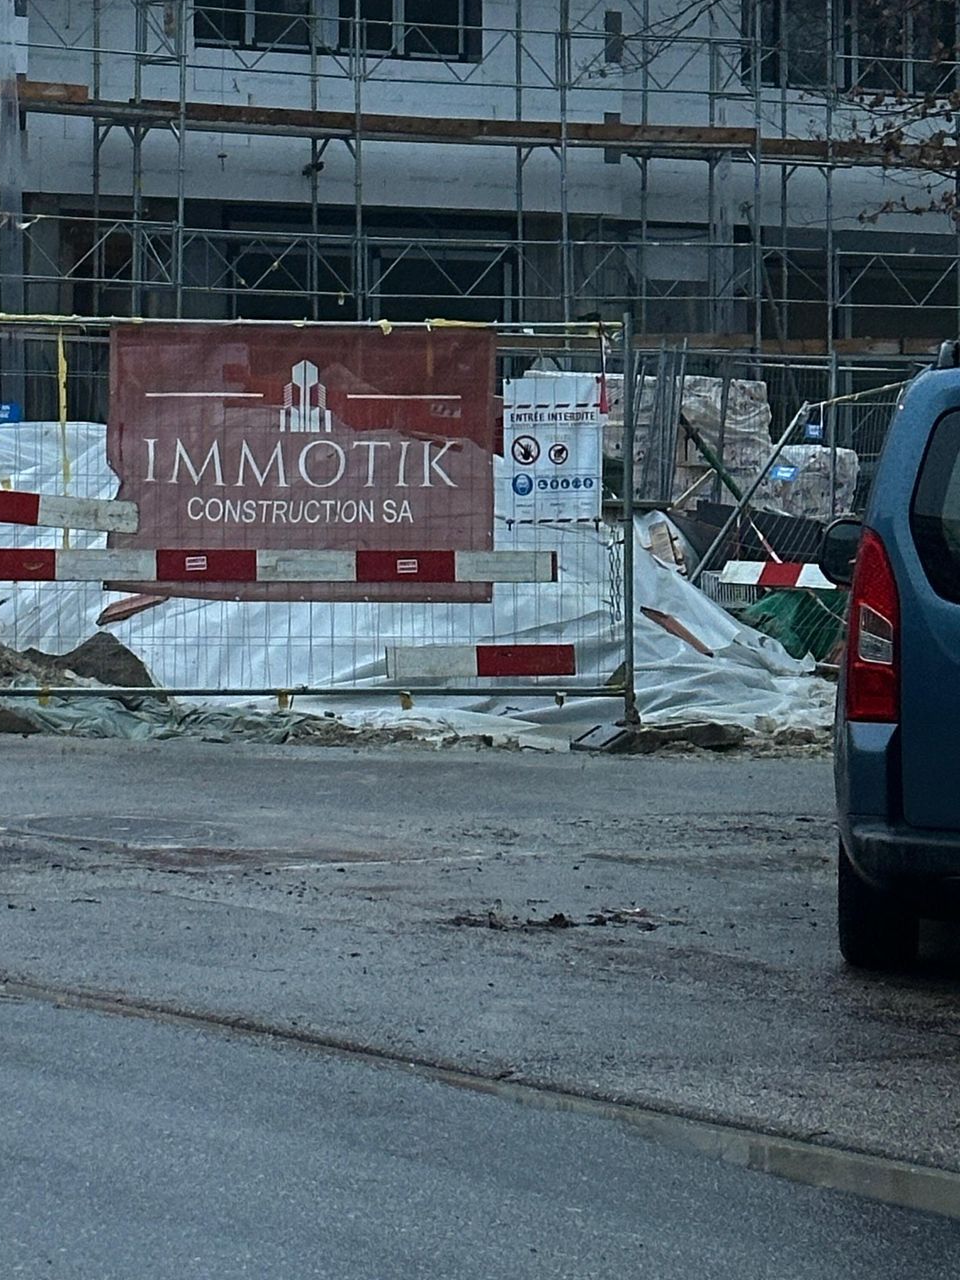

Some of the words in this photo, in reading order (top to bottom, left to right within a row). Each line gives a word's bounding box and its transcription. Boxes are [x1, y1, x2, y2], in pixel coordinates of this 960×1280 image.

[510, 410, 544, 422] ENTRÉE
[548, 411, 595, 421] INTERDITE
[143, 438, 458, 487] IMMOTIK
[187, 496, 374, 524] CONSTRUCTION
[382, 499, 413, 523] SA
